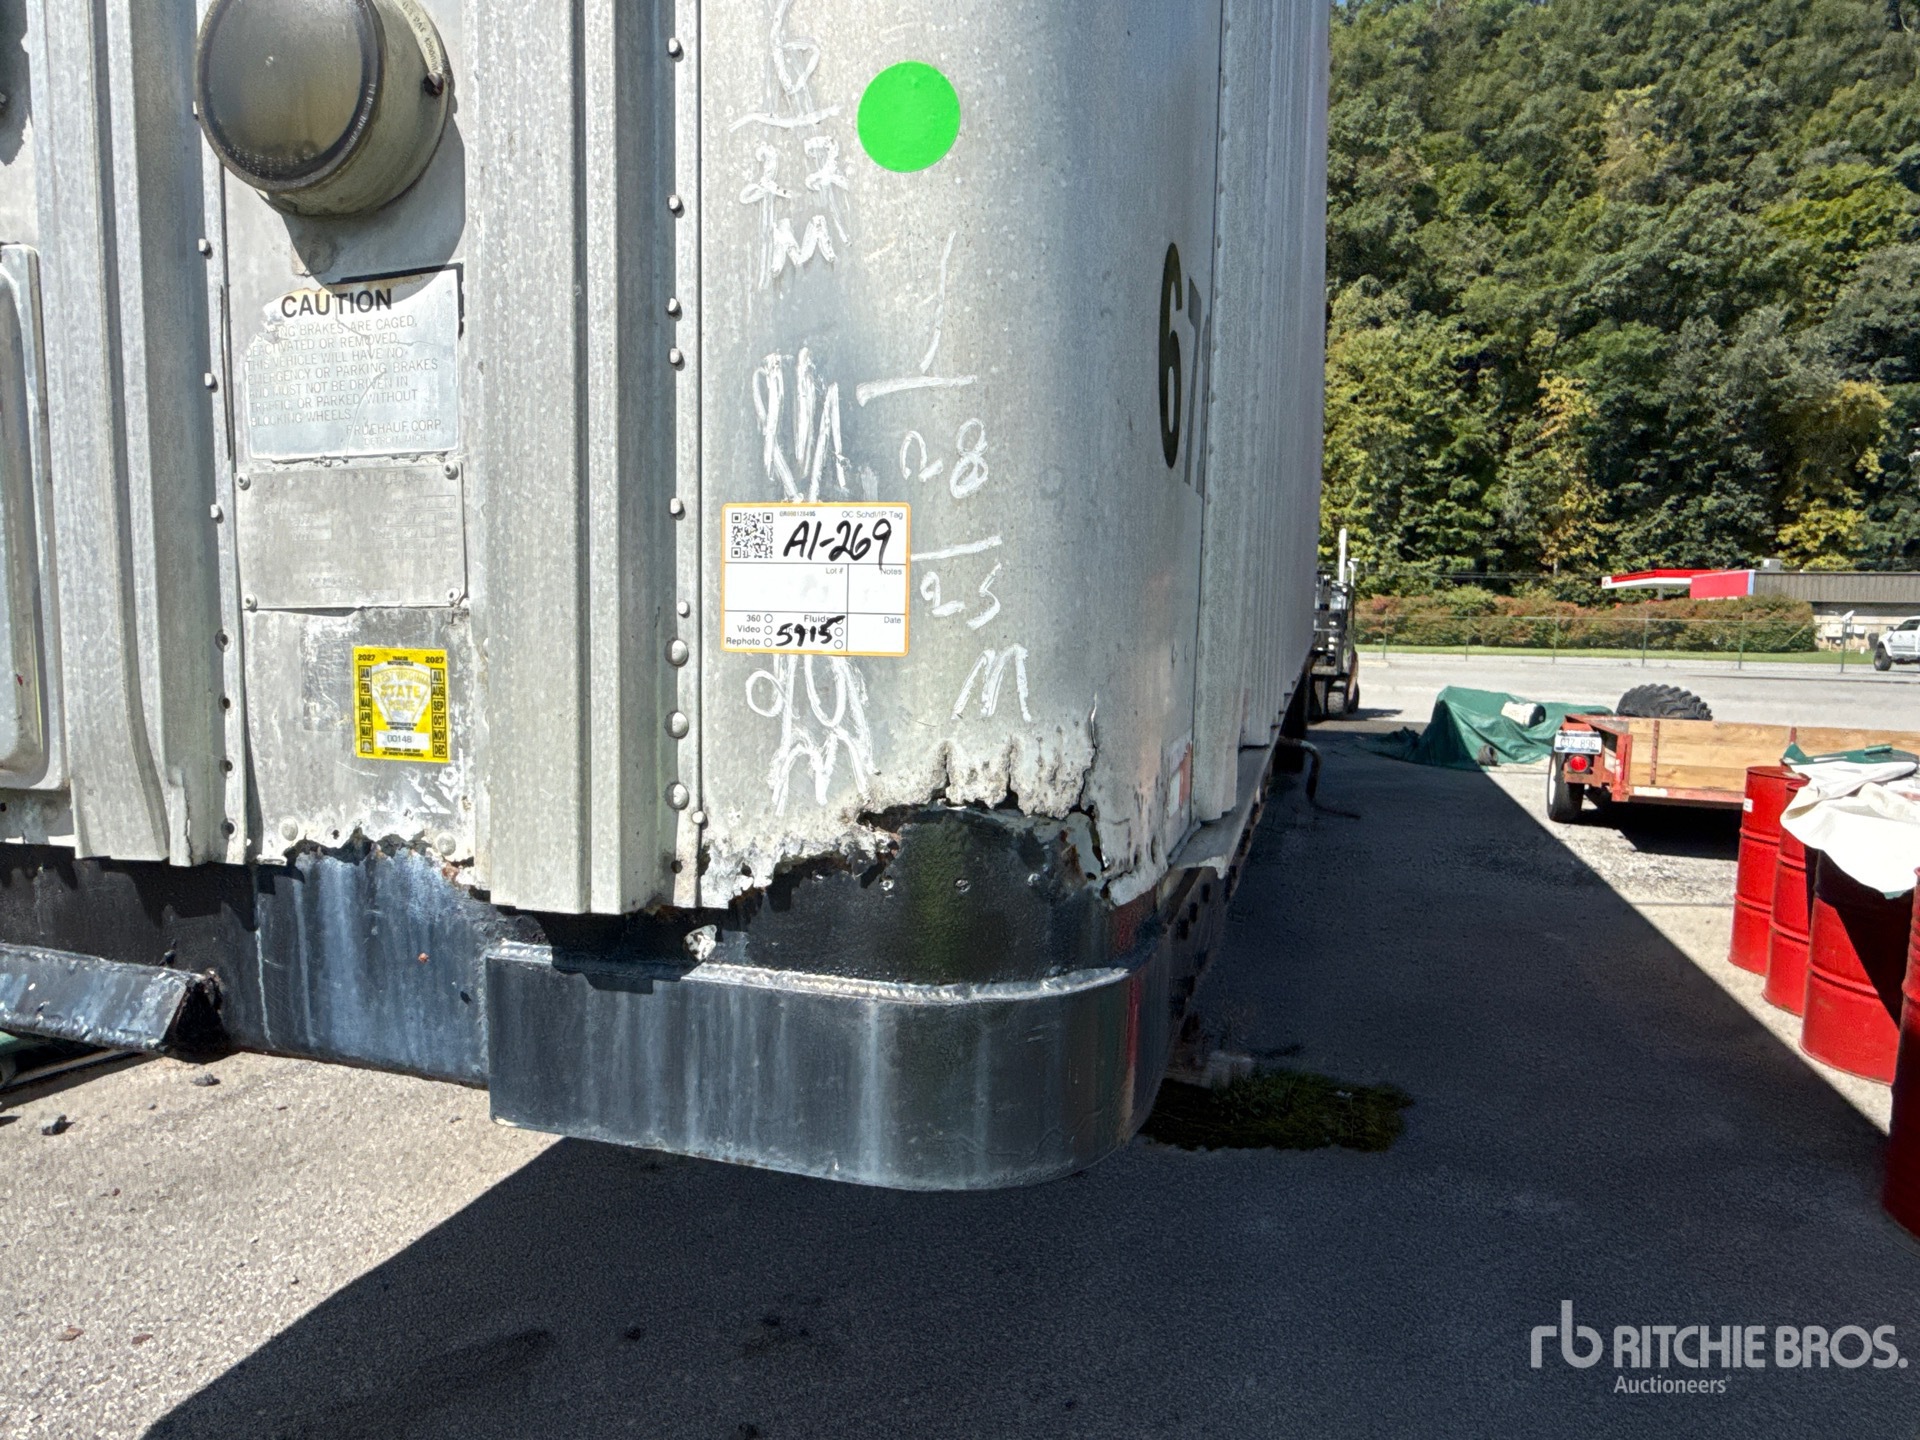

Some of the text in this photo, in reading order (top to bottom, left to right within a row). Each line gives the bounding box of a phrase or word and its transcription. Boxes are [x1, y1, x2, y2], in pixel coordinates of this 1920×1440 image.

[281, 288, 392, 318] CAUTION
[299, 322, 344, 336] BRAKES
[348, 320, 372, 333] ARE
[319, 337, 335, 349] OR
[246, 358, 269, 371] THIS
[272, 353, 317, 368] VEHICLE
[321, 351, 348, 364] WILL
[352, 347, 383, 361] HAVE
[248, 357, 439, 386] EMERGENCY OR PARKING BRAKES
[305, 380, 328, 394] NOT
[331, 378, 346, 391] BE
[349, 376, 393, 391] DRIVEN
[396, 375, 409, 388] IN
[297, 397, 312, 409] OR
[316, 393, 361, 407] PARKED
[366, 388, 418, 405] WITHOUT
[251, 411, 303, 428] BLOCKING
[841, 510, 855, 518] OC
[889, 511, 904, 520] Tag
[783, 518, 892, 571] A1-269
[880, 567, 903, 576] Notes
[883, 616, 902, 624] Date
[737, 625, 761, 633] Video
[776, 615, 846, 647] 5915
[726, 637, 761, 646] Rephoto
[357, 654, 376, 662] 2027
[425, 656, 444, 664] 2027
[380, 684, 421, 699] STATE
[432, 686, 444, 697] AUG
[433, 701, 444, 711] SEP
[433, 715, 445, 726] OCT
[386, 735, 413, 744] 00148
[433, 729, 445, 740] NOV
[434, 744, 445, 755] DEC
